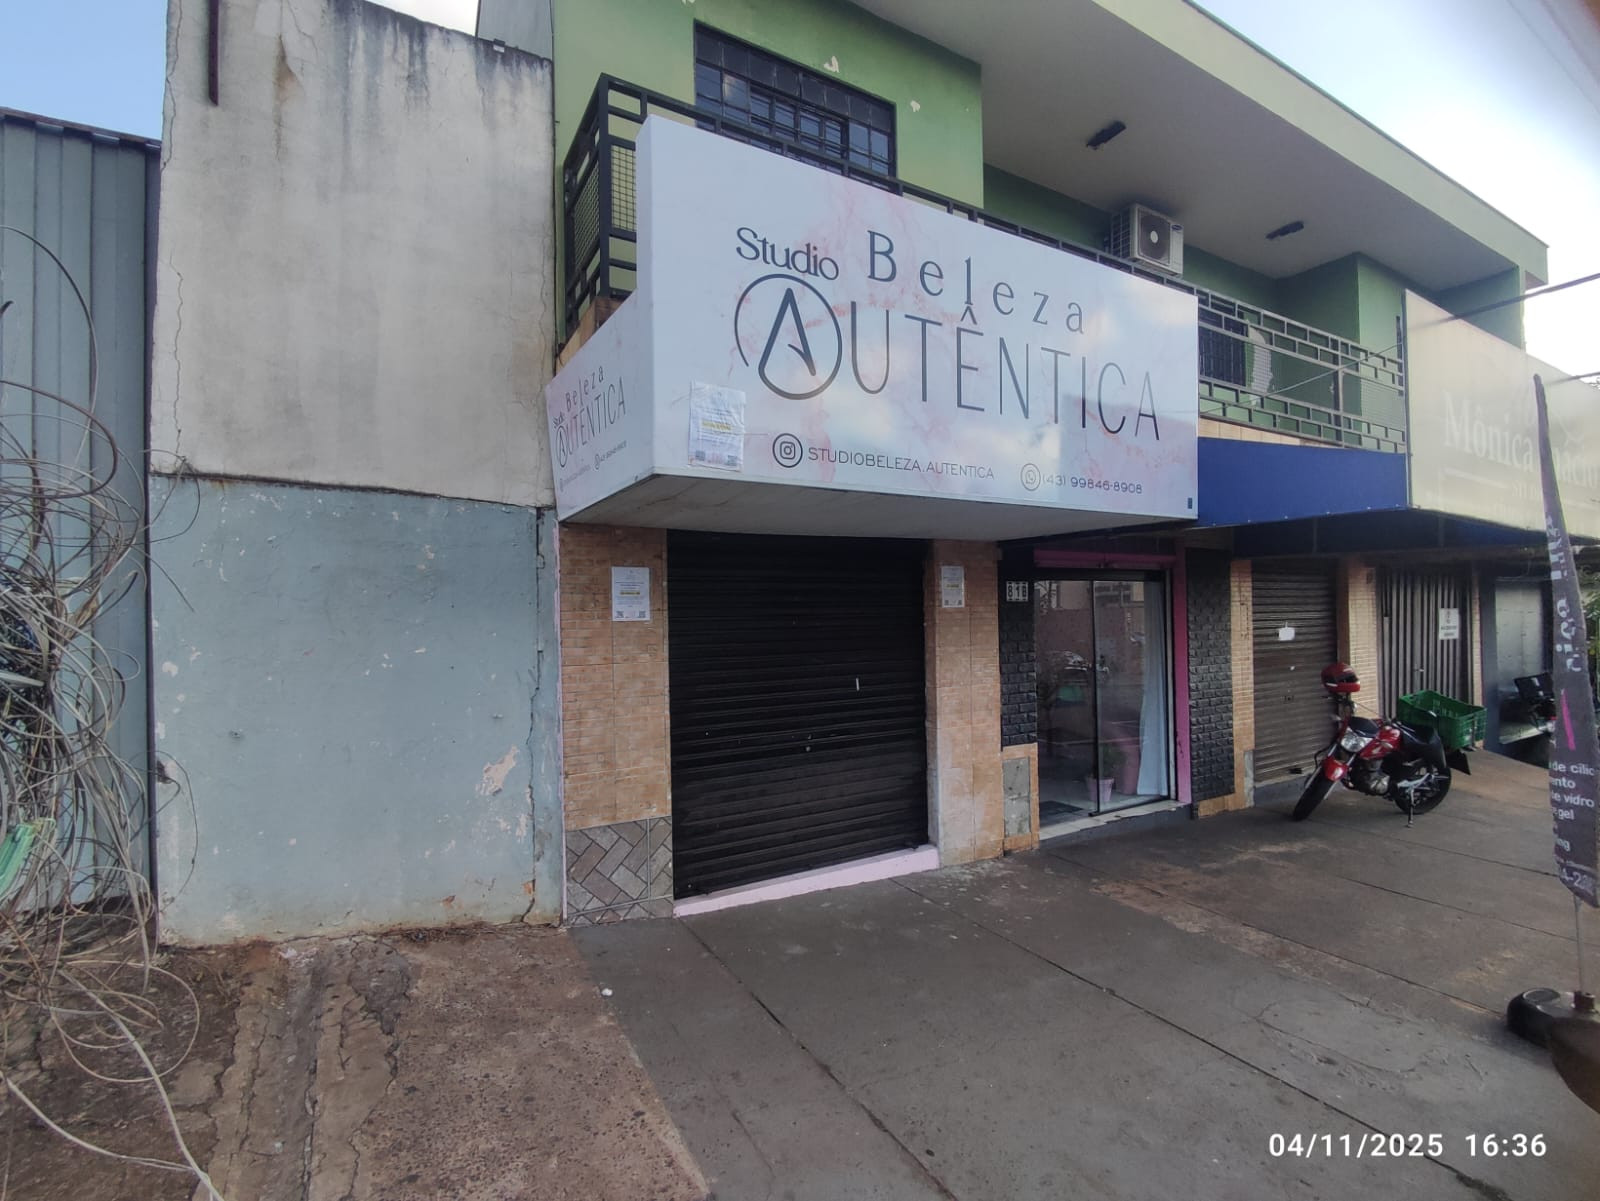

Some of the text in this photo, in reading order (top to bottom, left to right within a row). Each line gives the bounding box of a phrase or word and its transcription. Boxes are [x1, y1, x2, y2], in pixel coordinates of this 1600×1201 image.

[736, 227, 839, 280] Studio
[867, 229, 1085, 336] Beleza
[735, 274, 1160, 441] AUTÊNTICA
[565, 366, 604, 413] Beleza
[807, 447, 995, 480] STUDIOBELEZA.AUTENTICA
[1070, 476, 1143, 495] 99846-8908
[1563, 793, 1595, 808] vidro
